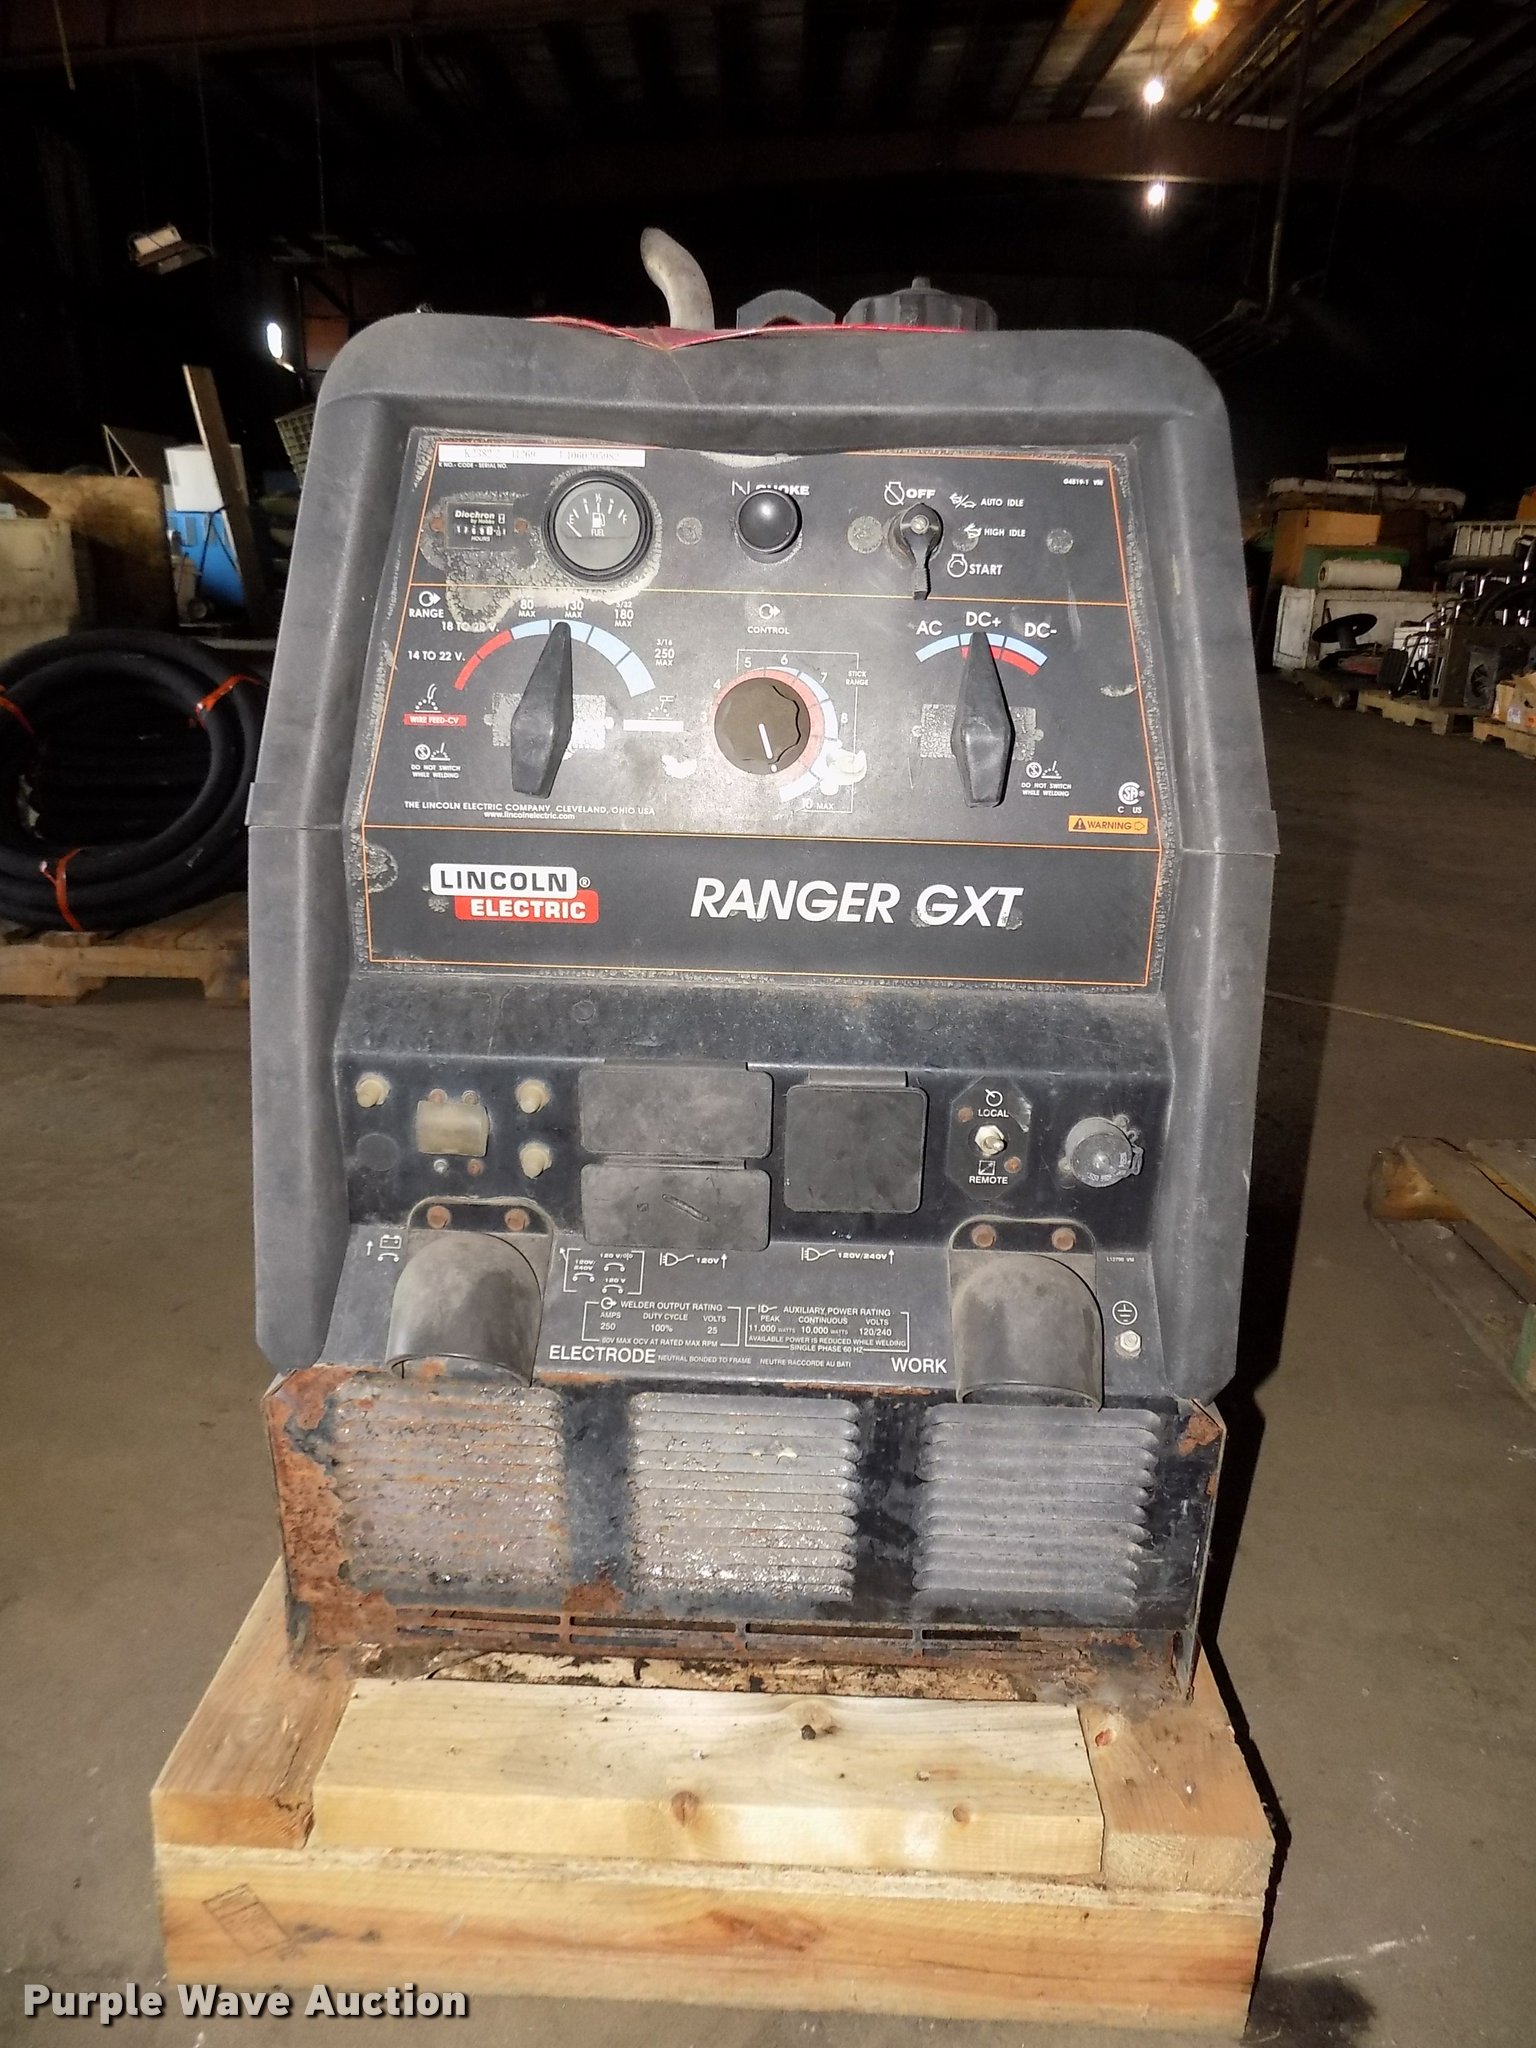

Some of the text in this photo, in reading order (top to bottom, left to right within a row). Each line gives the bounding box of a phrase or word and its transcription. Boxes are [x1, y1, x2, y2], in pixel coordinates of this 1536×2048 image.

[906, 488, 936, 500] OFF
[980, 498, 1024, 508] AUTO IDLE
[591, 528, 605, 536] FUEL
[984, 528, 1026, 538] HIGH IDLE
[969, 564, 1003, 576] START
[520, 600, 534, 610] 80
[565, 600, 584, 611] 130
[408, 608, 444, 619] RANGE
[564, 610, 582, 618] MAX
[614, 609, 634, 620] 180
[614, 620, 632, 628] MAX
[966, 612, 1002, 628] DC+
[442, 621, 453, 632] 18
[748, 626, 790, 635] CONTROL
[916, 620, 943, 636] AC
[1024, 623, 1057, 638] DC-
[656, 638, 673, 647] 3/16
[407, 650, 466, 662] 14 TO 22 V.
[654, 648, 675, 660] 250
[780, 654, 788, 665] 6
[744, 657, 752, 668] 5
[820, 672, 828, 682] 7
[712, 678, 722, 690] 4
[409, 716, 459, 725] WIRE FEED-CV
[700, 712, 708, 722] 3
[841, 713, 848, 724] 8
[404, 801, 420, 809] THE
[422, 802, 460, 810] LINCOLN
[463, 802, 503, 811] ELECTRIC
[556, 805, 609, 815] CLEVELAND,
[612, 806, 635, 816] OHIO
[638, 807, 655, 816] USA
[801, 799, 813, 809] 10
[484, 811, 575, 820] www.lincolnelectric.com
[1088, 821, 1132, 830] WARNING
[440, 870, 568, 892] LINCOLN
[690, 877, 1024, 928] RANGER GXT
[470, 898, 586, 919] ELECTRIC
[978, 1109, 1009, 1118] LOCAL
[968, 1176, 1008, 1185] REMOTE
[838, 1252, 887, 1260] 120V/240V
[620, 1301, 723, 1312] WELDER OUTPUT RATING
[784, 1306, 891, 1317] AUXILIARY POWER RATING
[798, 1316, 848, 1325] CONTINUOUS
[650, 1324, 673, 1332] 100%
[707, 1327, 718, 1335] 25
[859, 1328, 892, 1337] 120/240
[549, 1345, 656, 1364] ELECTRODE
[890, 1357, 948, 1374] WORK
